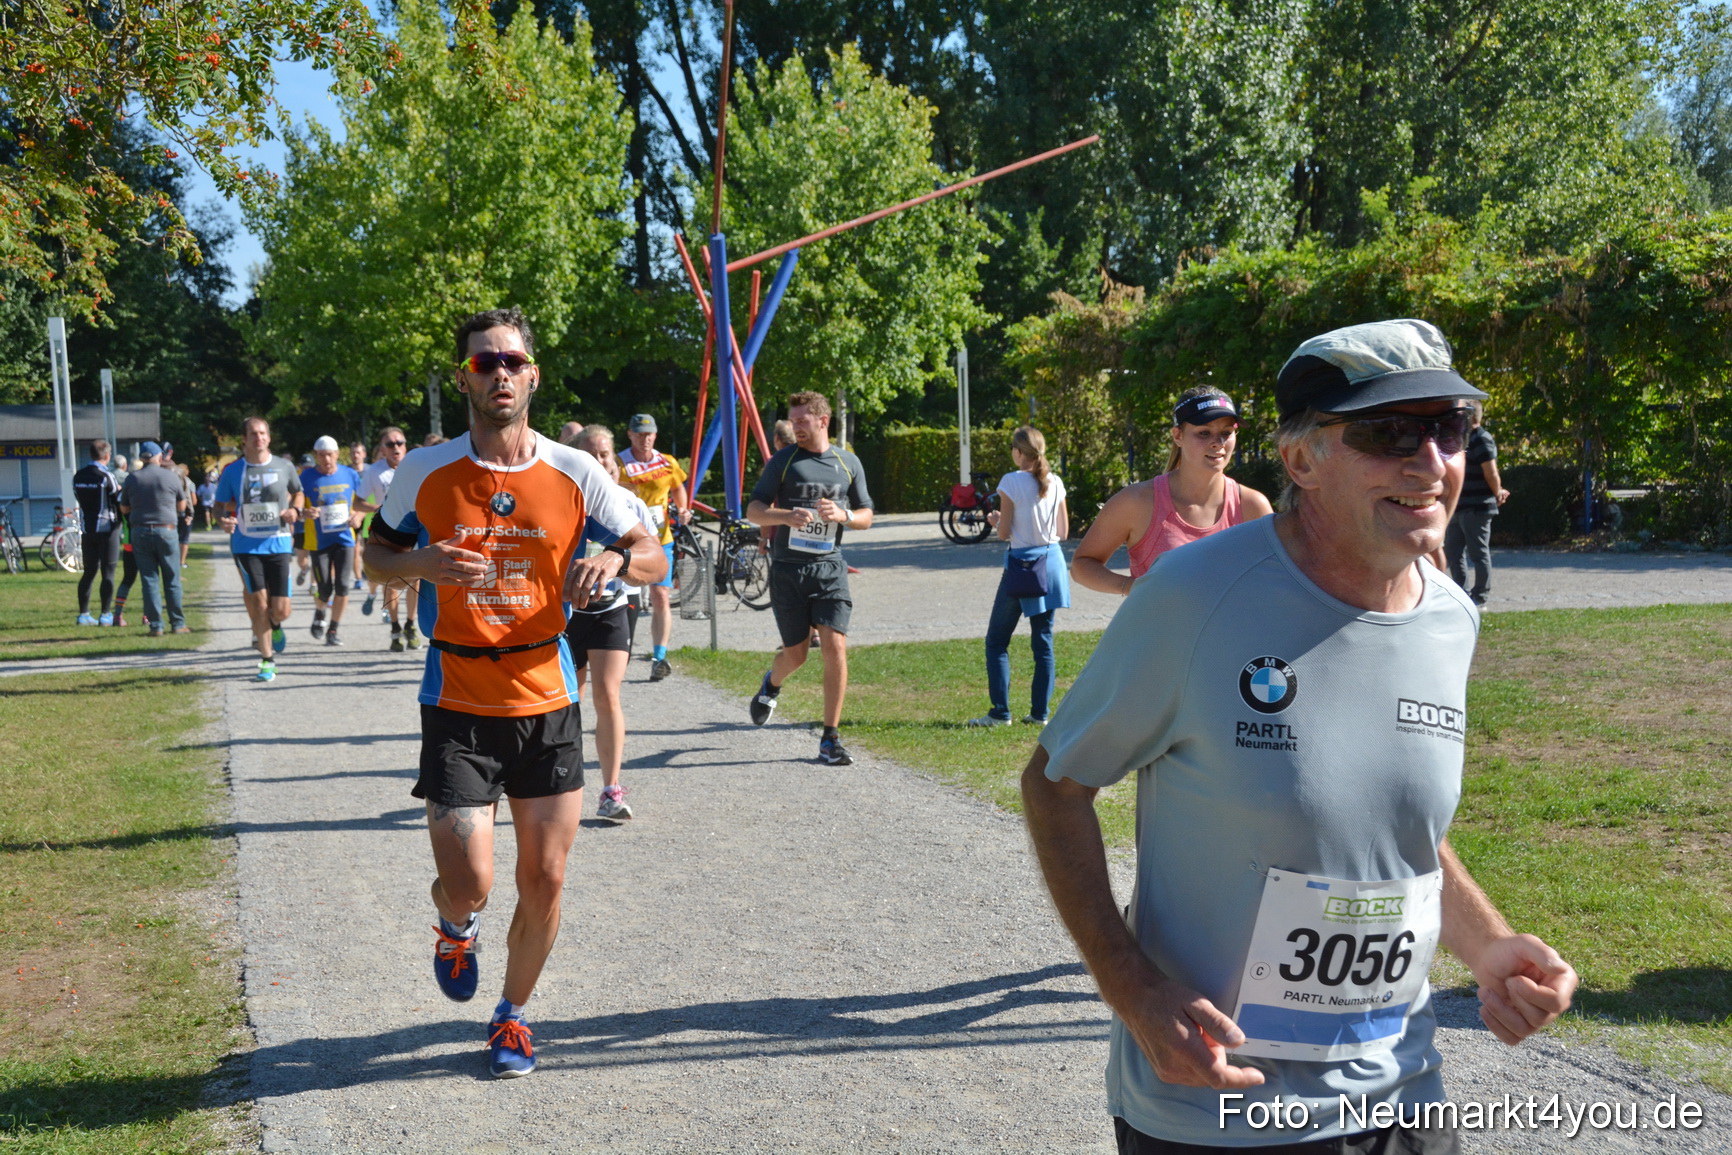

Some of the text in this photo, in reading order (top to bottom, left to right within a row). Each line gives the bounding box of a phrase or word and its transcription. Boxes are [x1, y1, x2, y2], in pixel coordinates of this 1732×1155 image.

[13, 445, 52, 456] KIOSK
[454, 524, 548, 538] SportScheck
[503, 559, 532, 570] Stadt
[503, 569, 529, 579] Lauf
[467, 592, 531, 607] Nürnberg
[1244, 657, 1295, 679] BMW
[1397, 698, 1464, 735] BOCK
[1236, 720, 1298, 740] PARTL
[1396, 724, 1426, 735] inspired
[1427, 728, 1435, 738] by
[1235, 737, 1298, 752] Neumarkt
[1323, 896, 1406, 918] BOCK
[1322, 915, 1350, 924] inspired
[1279, 927, 1416, 987] 3056
[1283, 990, 1380, 1007] PARTL Neumarkt
